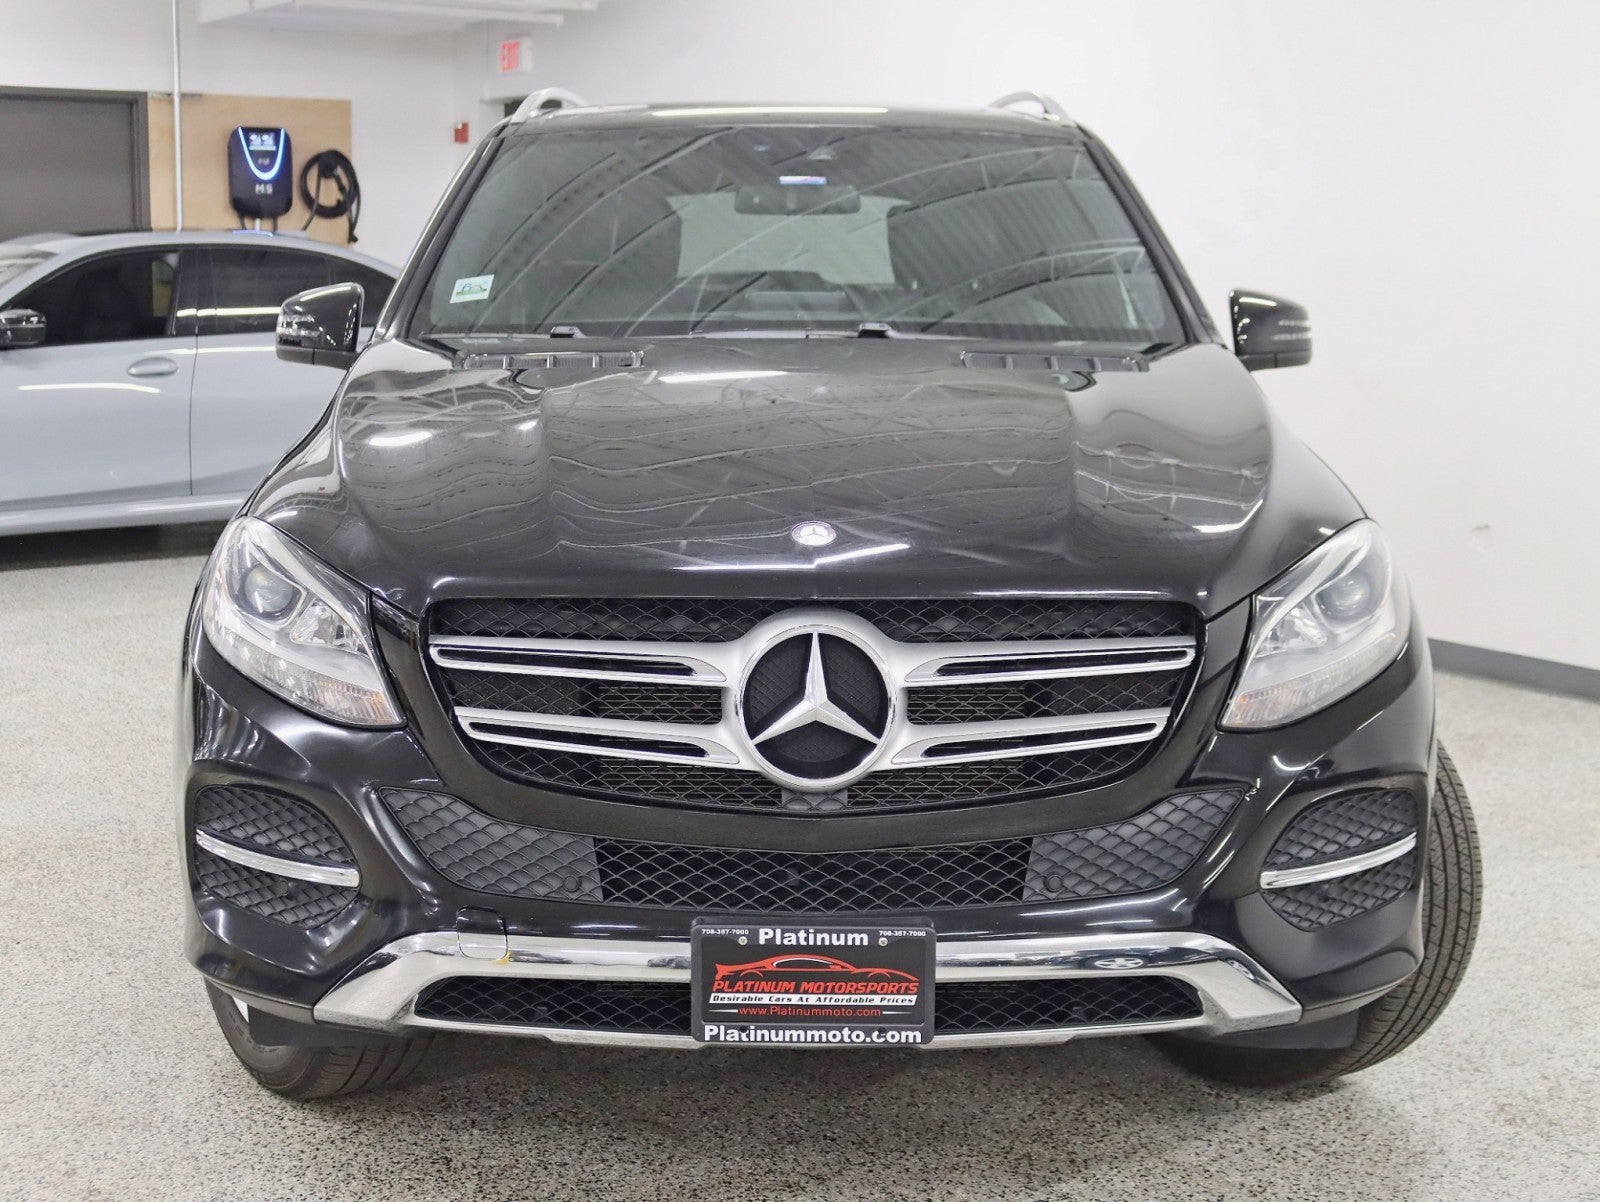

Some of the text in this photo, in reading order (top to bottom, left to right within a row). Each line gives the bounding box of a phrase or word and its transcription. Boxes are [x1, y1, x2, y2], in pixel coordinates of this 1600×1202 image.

[759, 928, 869, 946] Platinum
[712, 980, 919, 994] PLATINUM MOTORSPORTS
[739, 1006, 881, 1016] www.Platinummoto.com
[704, 1025, 922, 1043] Platinummoto.com
